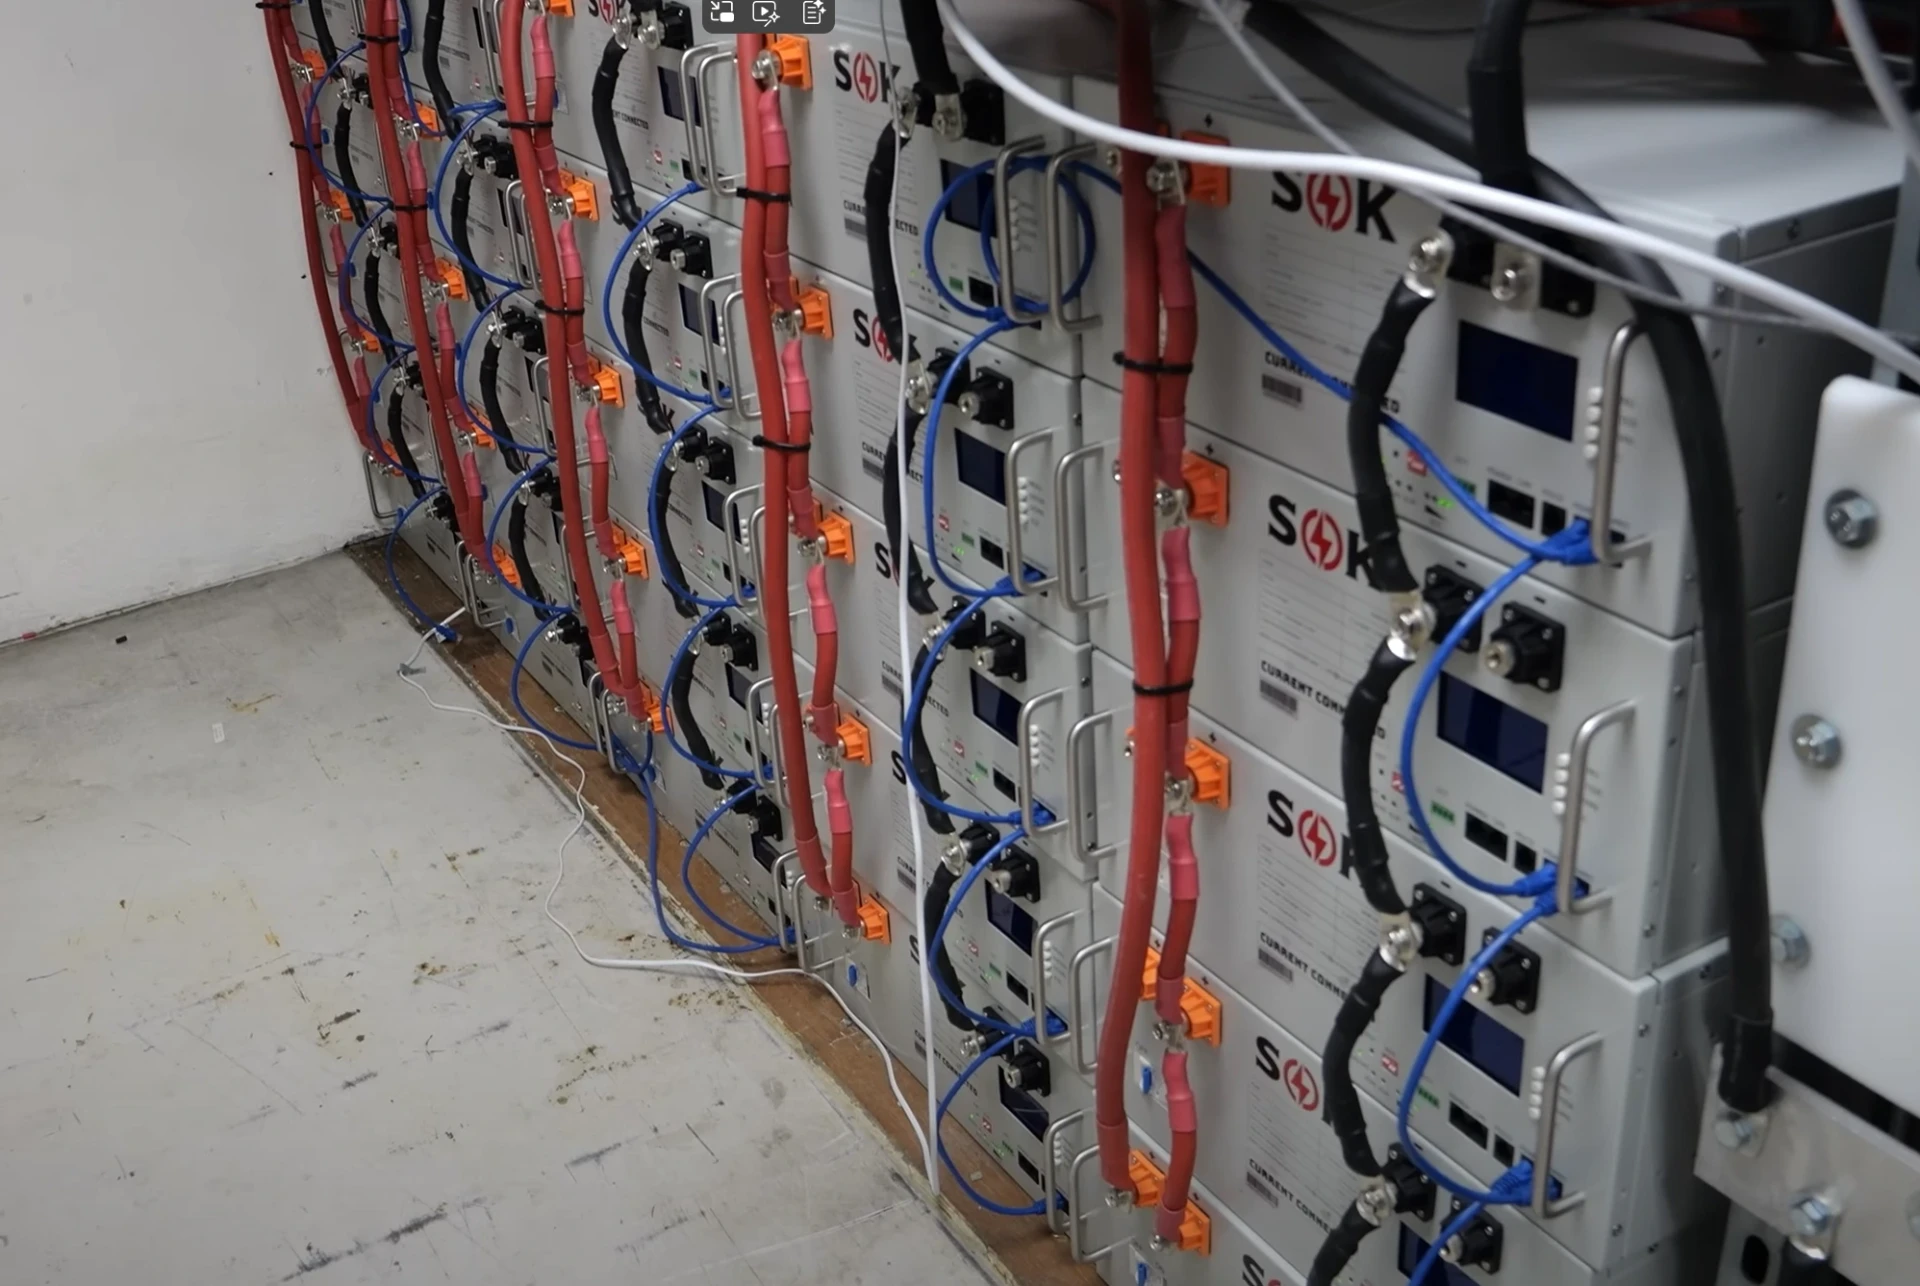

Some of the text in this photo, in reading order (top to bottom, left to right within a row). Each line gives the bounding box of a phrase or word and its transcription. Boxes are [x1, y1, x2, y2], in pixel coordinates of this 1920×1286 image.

[833, 49, 901, 103] SOK
[843, 199, 919, 236] CURR ECTED
[1271, 171, 1397, 244] SOK
[862, 441, 886, 461] CURRE
[881, 660, 903, 682] CURRE
[1261, 659, 1313, 698] CURRENT
[1260, 931, 1349, 1001] CURRENT CONNE
[1256, 1035, 1320, 1112] SO
[1248, 1158, 1332, 1236] CURRENT CONNE
